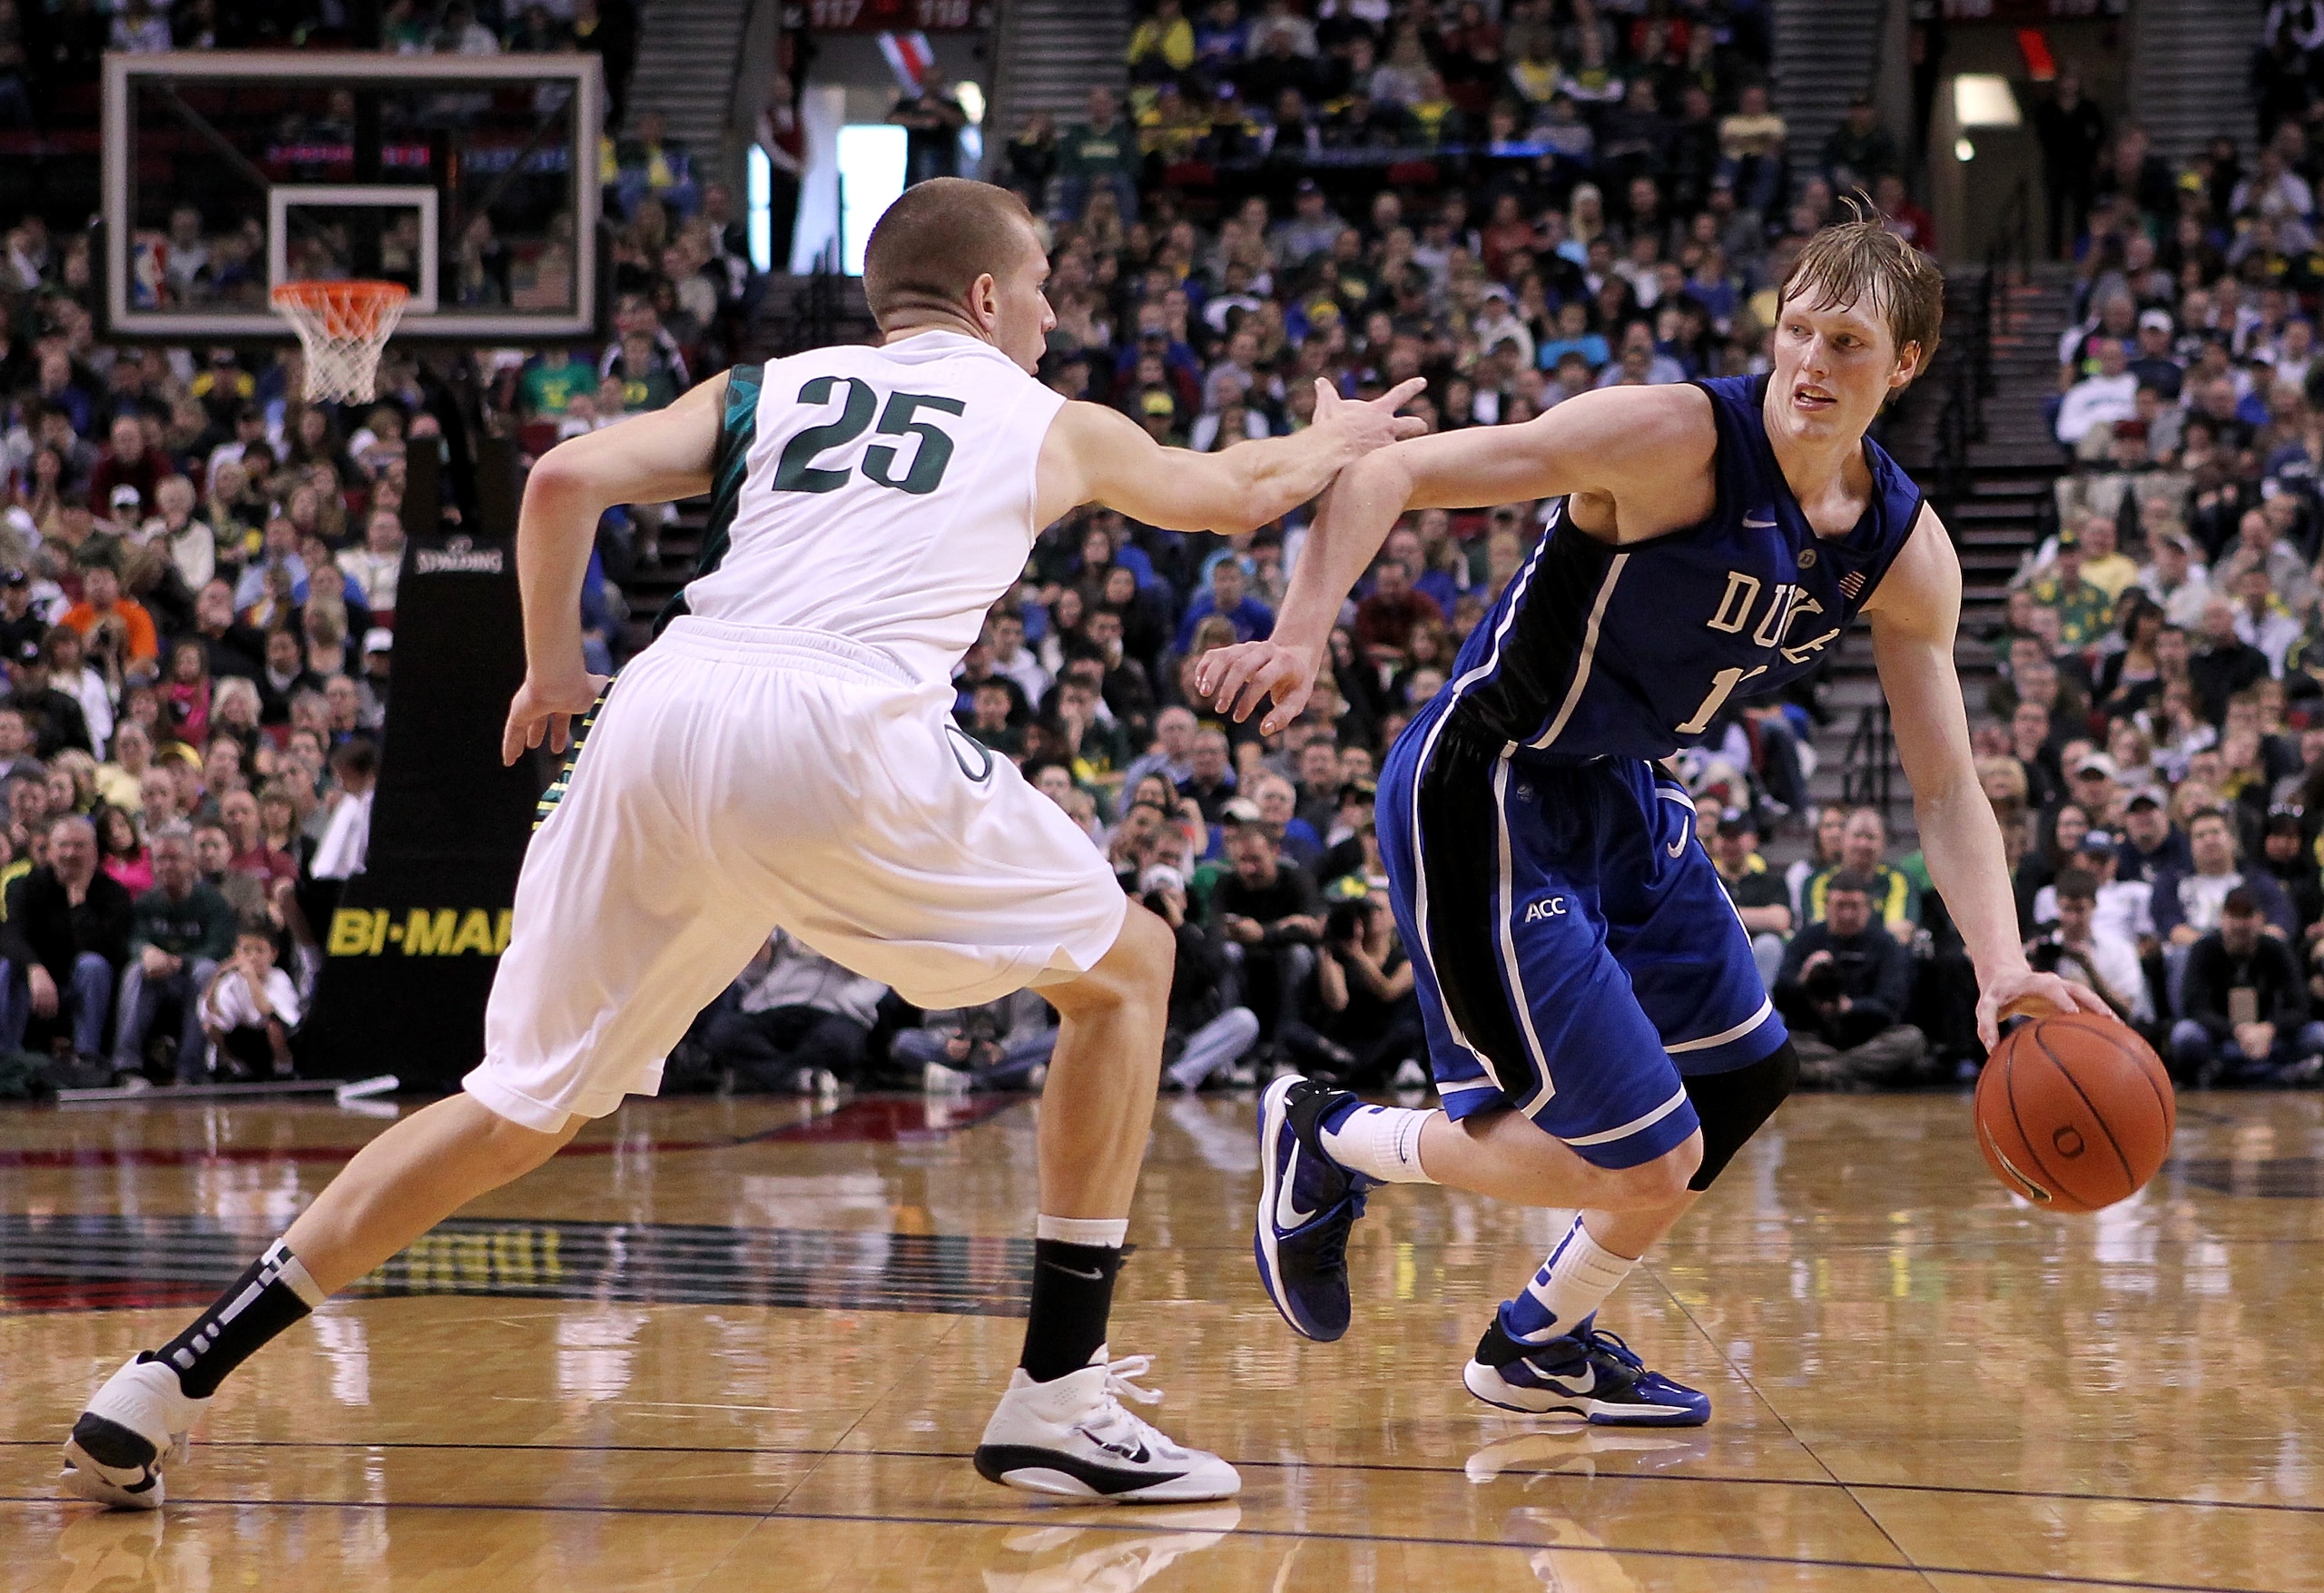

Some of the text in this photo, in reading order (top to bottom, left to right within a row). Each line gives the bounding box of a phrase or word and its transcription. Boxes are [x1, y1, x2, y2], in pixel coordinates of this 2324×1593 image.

[772, 376, 967, 495] 25
[1674, 665, 1768, 734] 1
[1525, 897, 1566, 923] ACC
